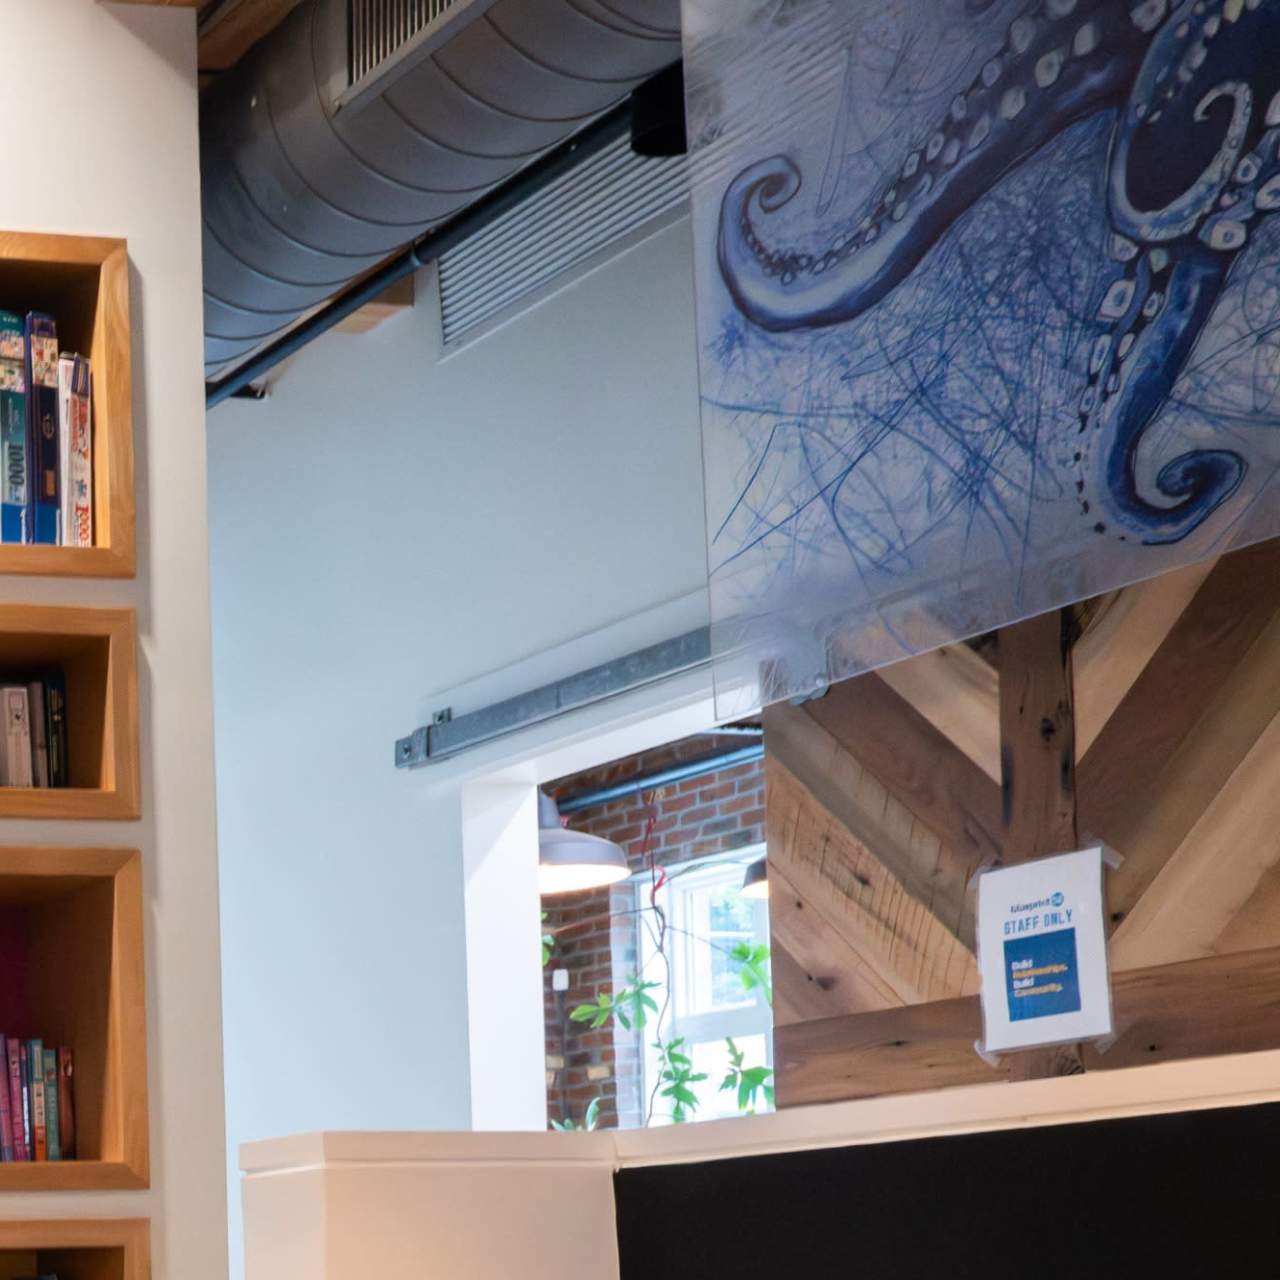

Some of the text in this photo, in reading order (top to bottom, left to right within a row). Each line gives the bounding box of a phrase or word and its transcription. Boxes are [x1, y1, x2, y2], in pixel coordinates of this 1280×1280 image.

[6, 442, 25, 487] 1000
[75, 503, 90, 541] 1000
[1003, 908, 1073, 936] STAFF ONLY
